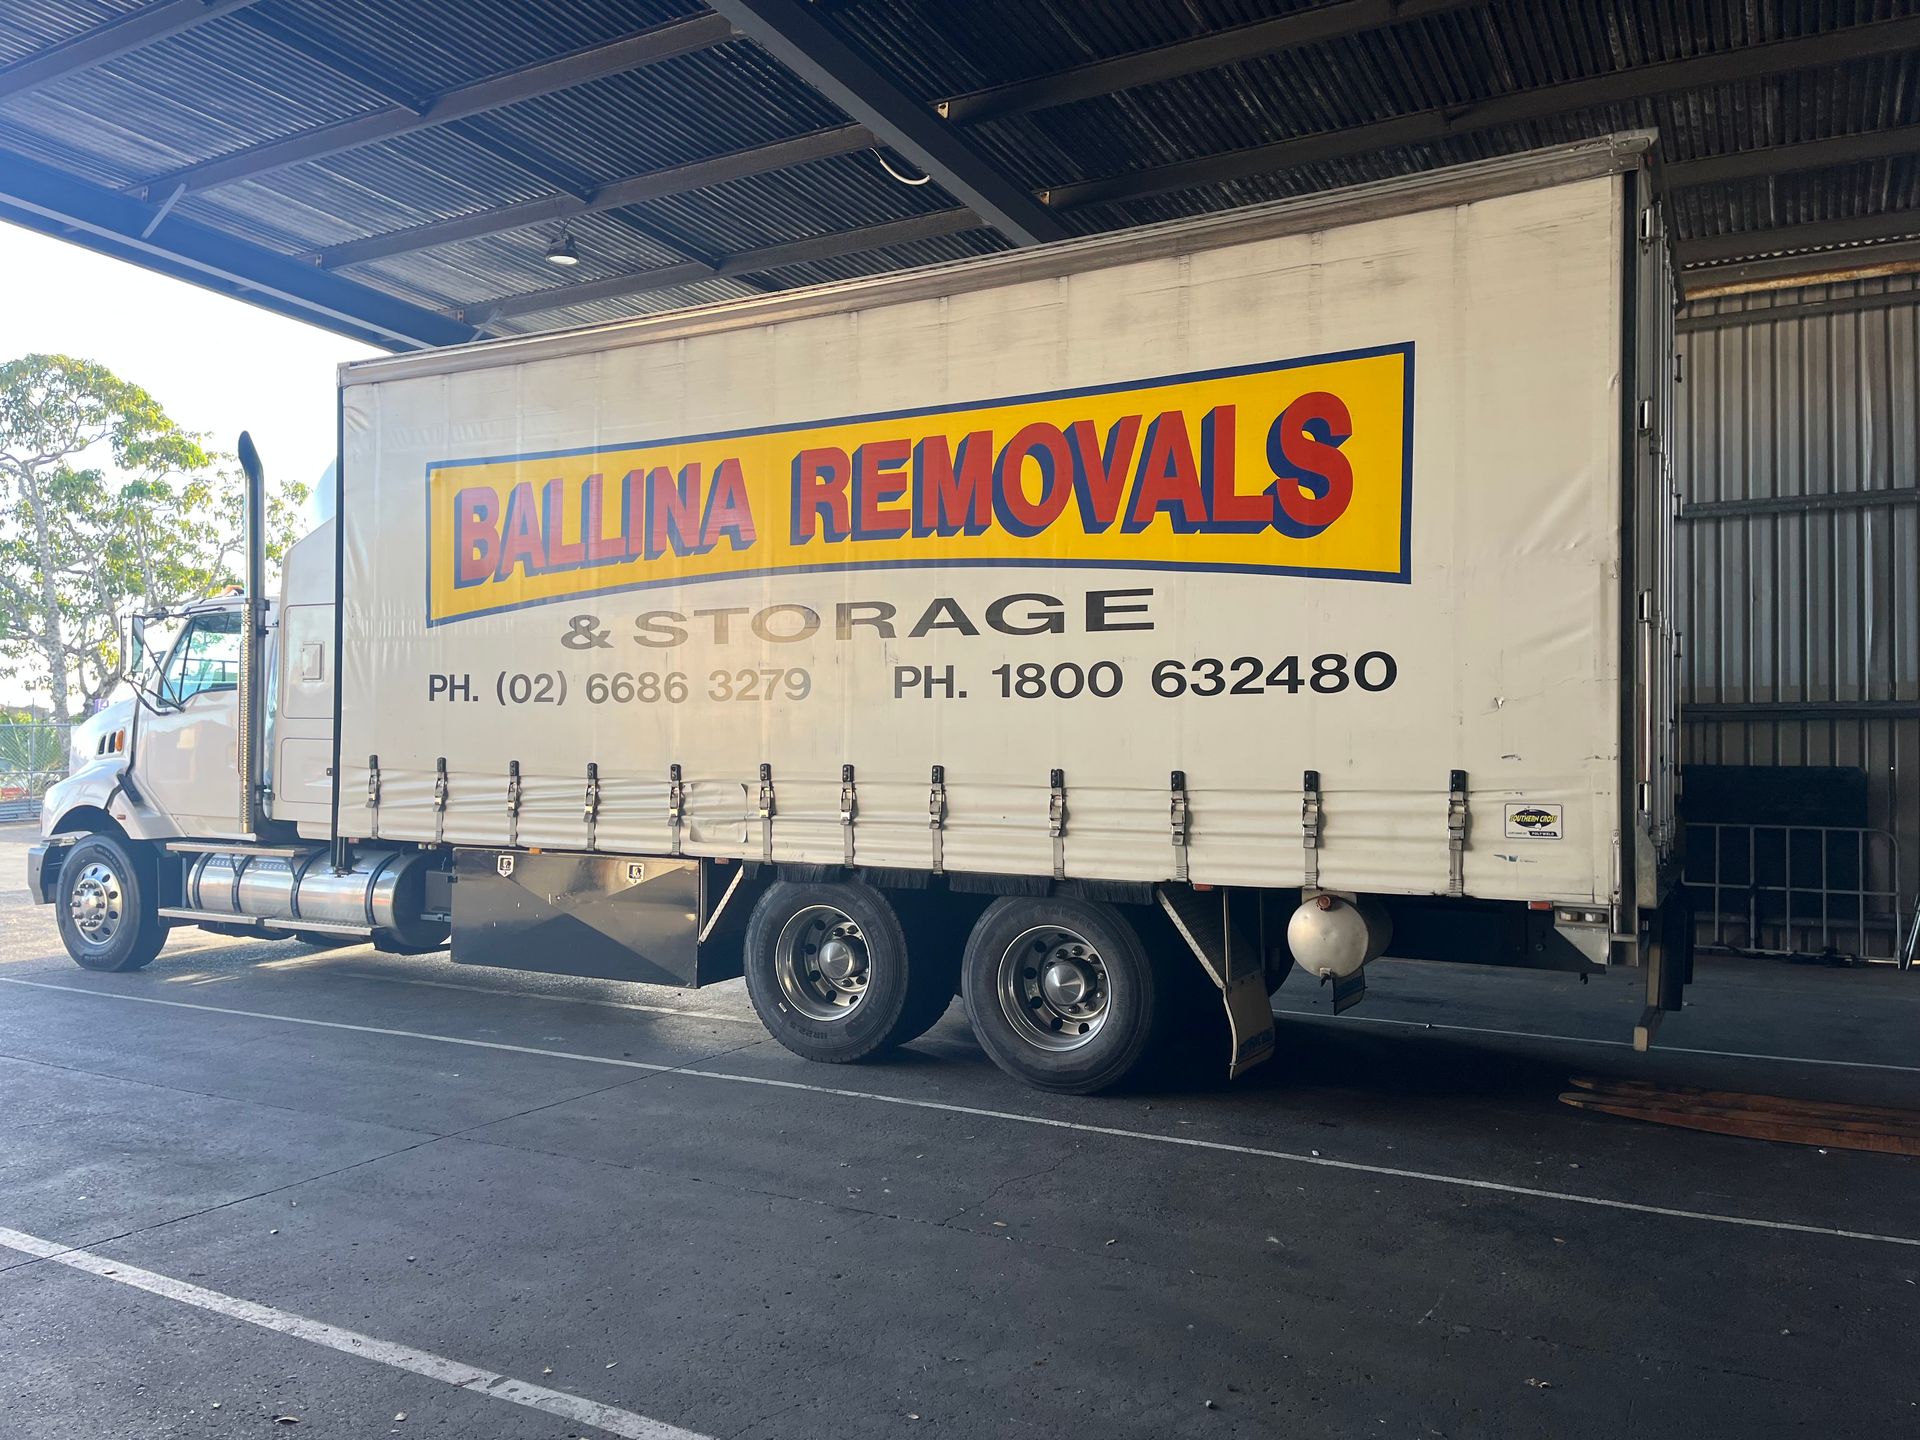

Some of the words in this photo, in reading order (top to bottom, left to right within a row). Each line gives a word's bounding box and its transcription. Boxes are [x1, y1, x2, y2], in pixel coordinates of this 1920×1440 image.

[454, 458, 757, 590] BALLINA
[790, 391, 1354, 546] REMOVALS
[560, 614, 615, 650] &
[633, 587, 1156, 649] STORAGE
[429, 673, 479, 702] PH.
[496, 670, 568, 706] (02)
[585, 670, 690, 704] 6686
[708, 667, 812, 701] 3279
[893, 665, 968, 700] PH.
[991, 660, 1124, 699] 1800
[1150, 651, 1398, 698] 632480
[1509, 814, 1540, 823] SOUTHERN
[1540, 815, 1558, 823] CROSS
